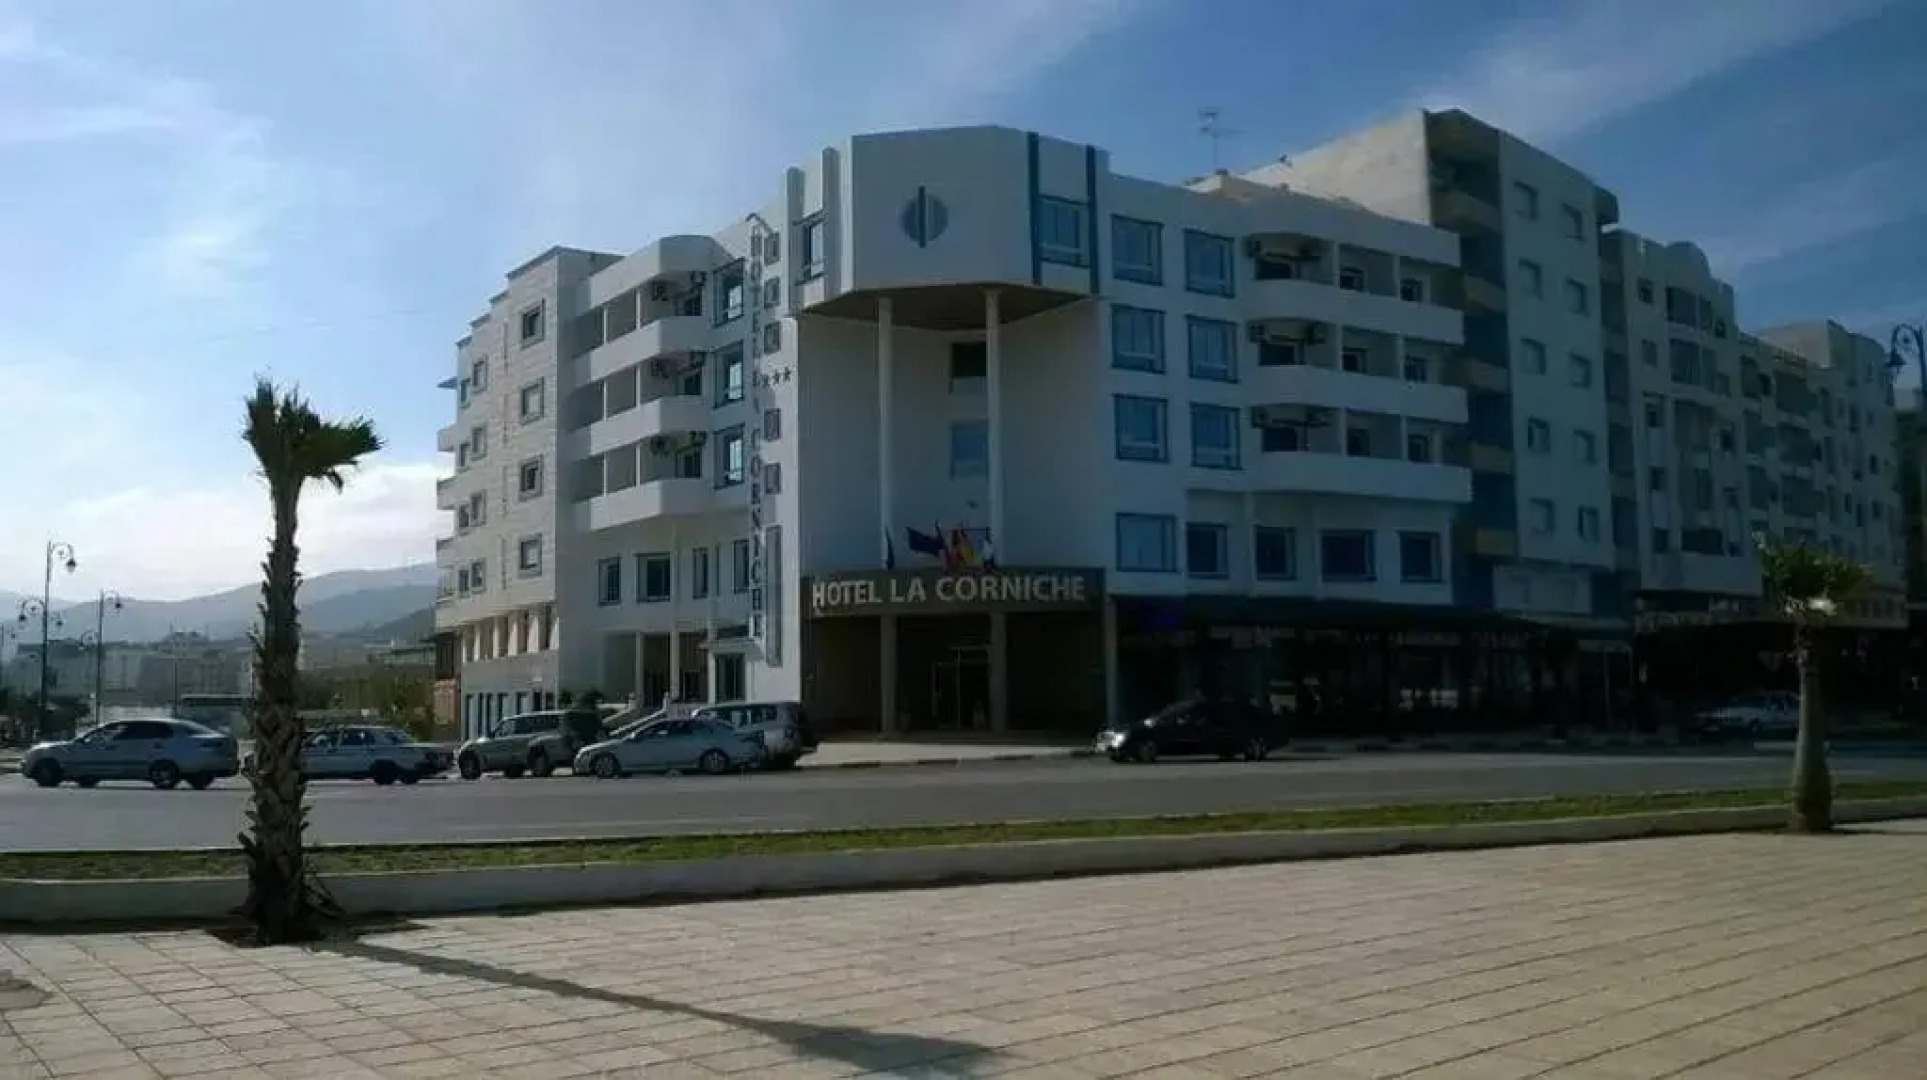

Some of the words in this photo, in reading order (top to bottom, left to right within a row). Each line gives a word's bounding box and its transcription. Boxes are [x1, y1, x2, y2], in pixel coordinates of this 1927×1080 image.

[751, 428, 762, 638] CORNICHE
[890, 578, 926, 603] LA
[935, 575, 1086, 602] CORNICHE
